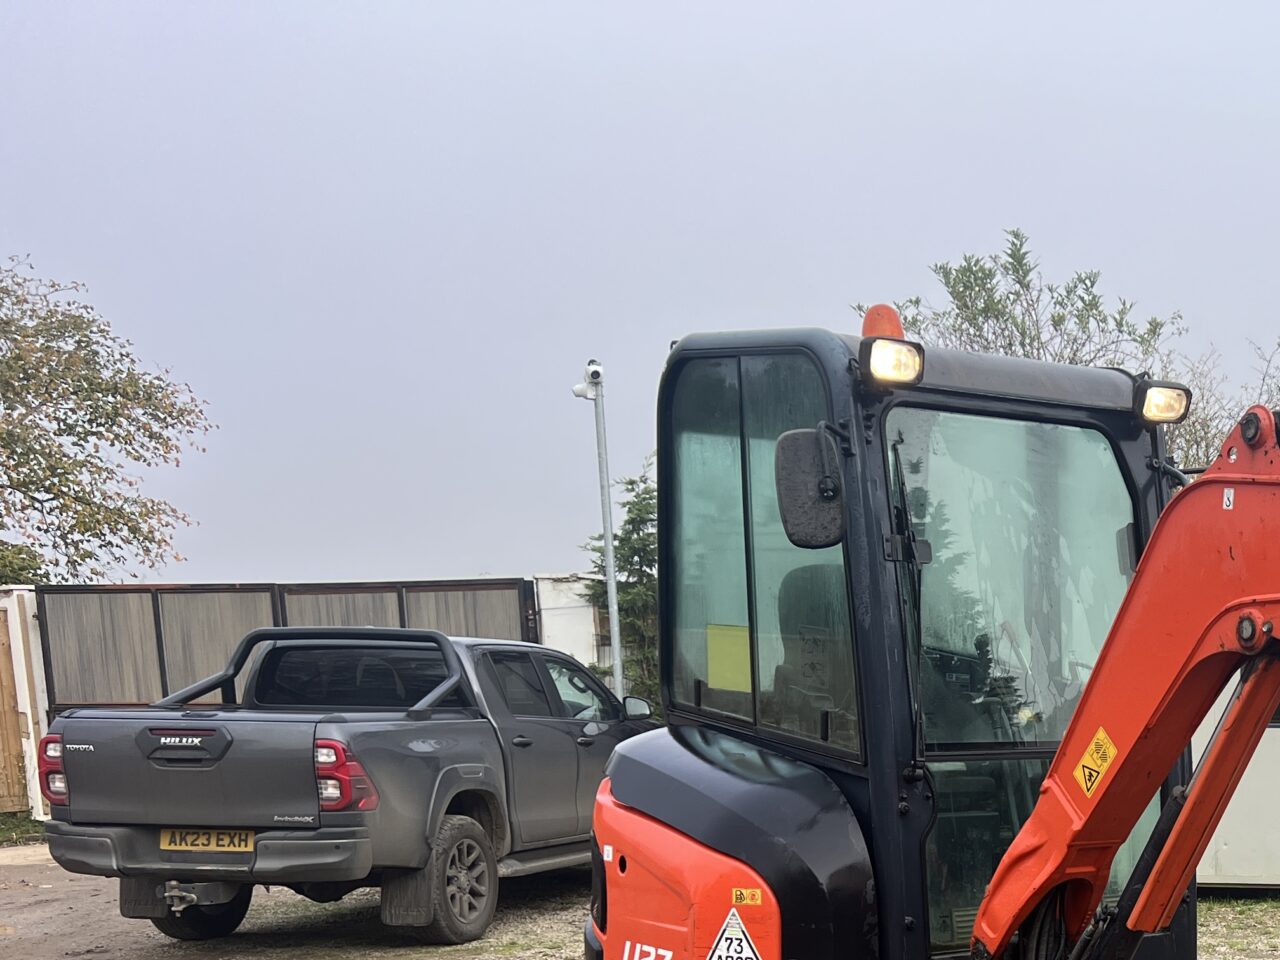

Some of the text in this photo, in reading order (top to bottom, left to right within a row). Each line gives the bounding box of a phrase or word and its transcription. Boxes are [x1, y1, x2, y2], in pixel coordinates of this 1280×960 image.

[65, 744, 95, 752] TOYOTA
[160, 737, 202, 746] HILUX
[168, 831, 249, 849] AK23 EXH
[724, 937, 744, 955] 73
